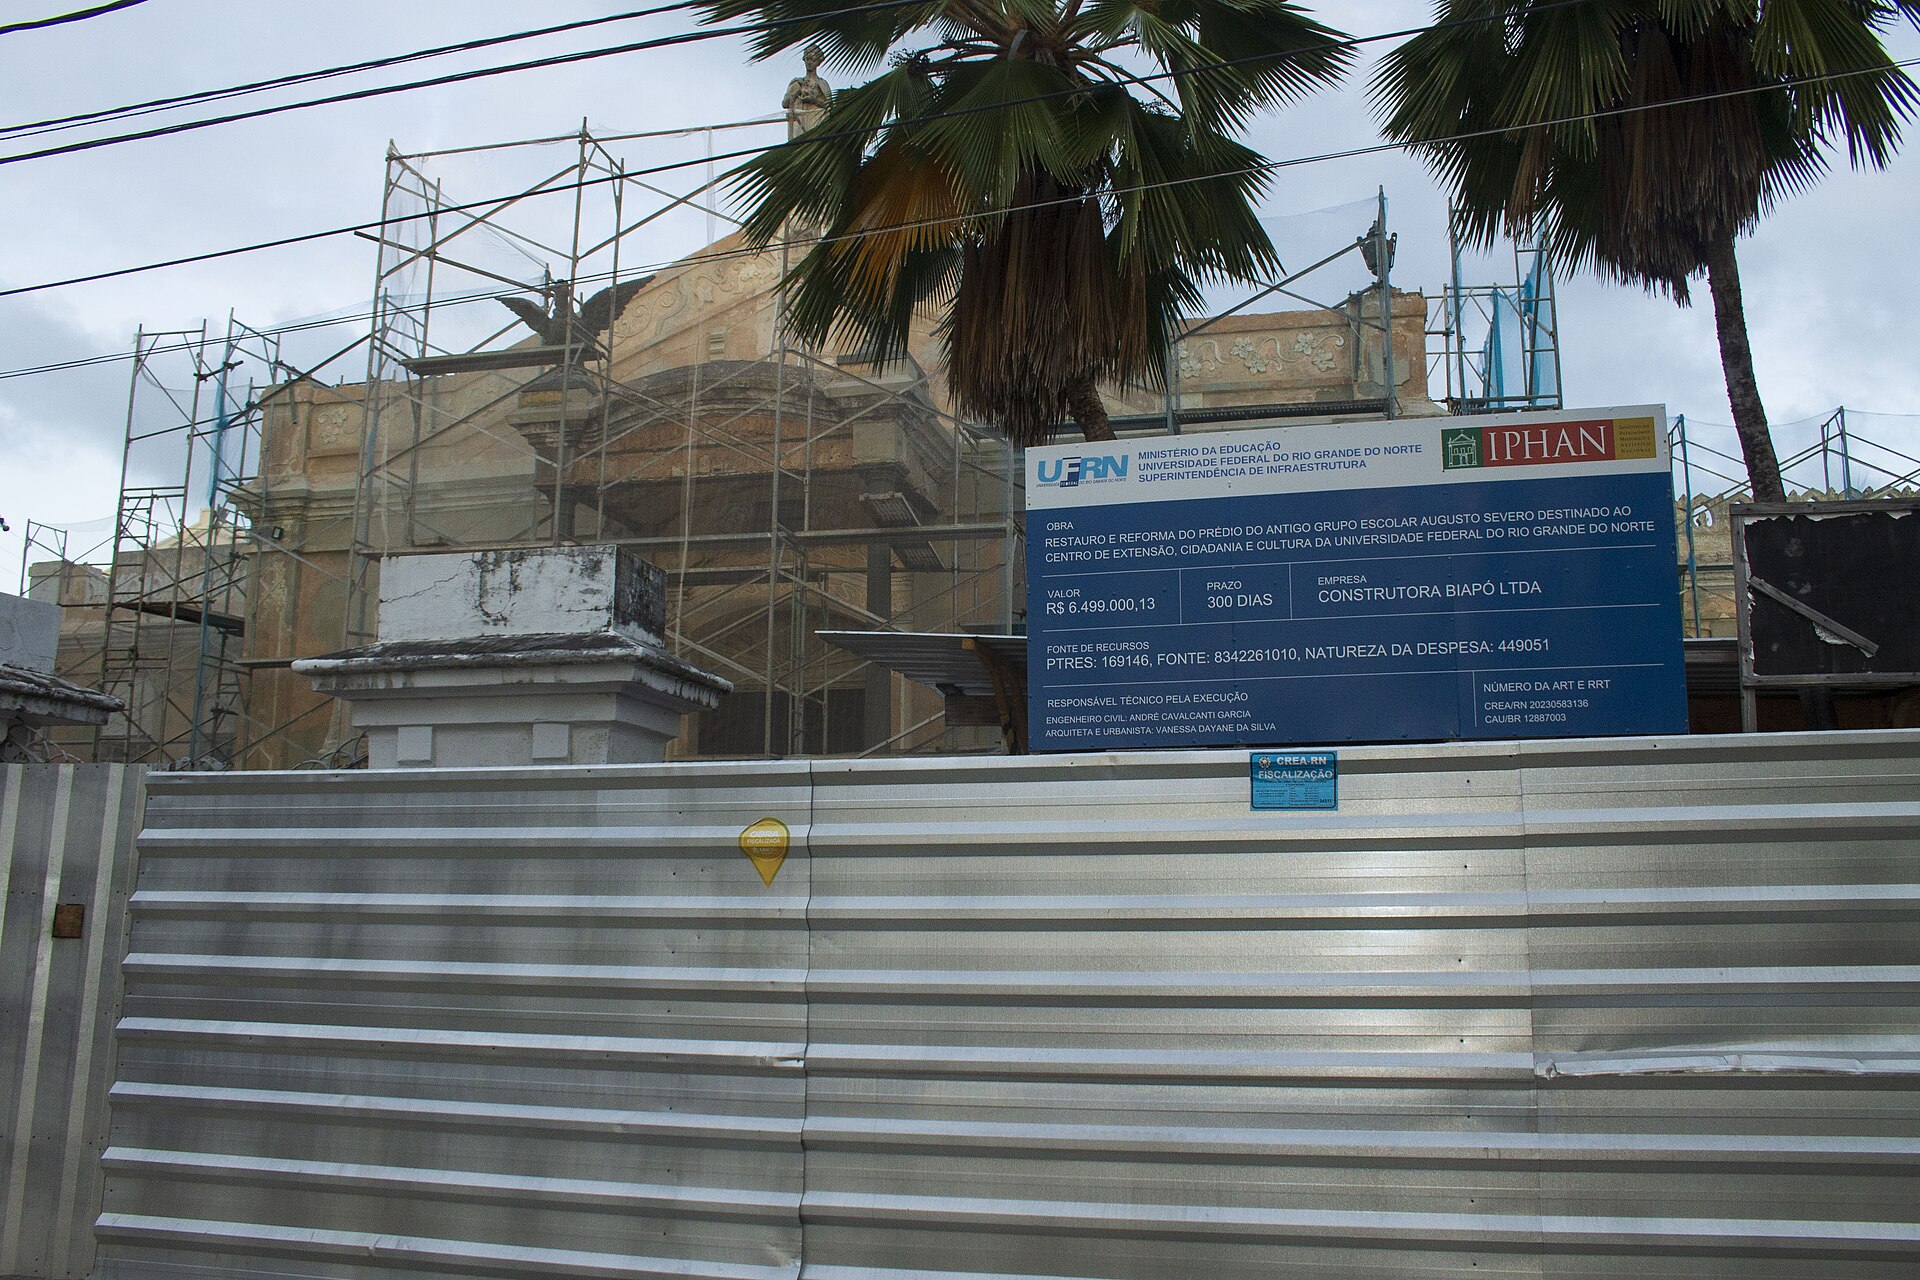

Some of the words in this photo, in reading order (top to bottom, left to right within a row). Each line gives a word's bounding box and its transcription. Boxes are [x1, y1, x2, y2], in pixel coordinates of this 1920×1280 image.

[1488, 425, 1607, 461] IPHAN
[1138, 447, 1199, 460] MINISTÉRIO
[1202, 447, 1216, 456] DA
[1220, 441, 1280, 454] EDUCAÇÃO
[1138, 458, 1218, 472] UNIVERSIDADE
[1220, 454, 1270, 466] FEDERAL
[1273, 453, 1289, 462] DO
[1292, 452, 1311, 461] RIO
[1314, 448, 1361, 459] GRANDE
[1364, 447, 1380, 456] DO
[1384, 444, 1422, 455] NORTE
[1038, 454, 1128, 482] UFRN
[1138, 468, 1246, 482] SUPERINTENDÊNCIA
[1249, 466, 1264, 475] DE
[1266, 460, 1366, 474] INFRAESTRUTURA
[1046, 522, 1074, 530] OBRA
[1046, 535, 1106, 548] RESTAURO
[1109, 534, 1116, 544] E
[1120, 530, 1176, 542] REFORMA
[1178, 530, 1196, 540] DO
[1199, 526, 1242, 538] PRÉDIO
[1246, 526, 1263, 536] DO
[1266, 523, 1310, 534] ANTIGO
[1314, 520, 1358, 532] GRUPO
[1360, 517, 1418, 529] ESCOLAR
[1420, 514, 1480, 526] AUGUSTO
[1484, 511, 1534, 522] SEVERO
[1538, 507, 1610, 520] DESTINADO
[1613, 506, 1632, 516] AO
[1046, 550, 1092, 562] CENTRO
[1094, 550, 1110, 560] DE
[1114, 544, 1177, 558] EXTENSÃO,
[1180, 542, 1243, 555] CIDADANIA
[1246, 542, 1253, 550] E
[1256, 538, 1312, 550] CULTURA
[1316, 537, 1332, 547] DA
[1334, 533, 1424, 546] UNIVERSIDADE
[1428, 530, 1482, 541] FEDERAL
[1486, 528, 1504, 538] DO
[1508, 526, 1530, 538] RIO
[1533, 524, 1586, 536] GRANDE
[1590, 523, 1608, 534] DO
[1612, 521, 1655, 532] NORTE
[1206, 580, 1242, 591] PRAZO
[1318, 575, 1367, 586] EMPRESA
[1047, 589, 1080, 598] VALOR
[1318, 585, 1441, 603] CONSTRUTORA
[1446, 580, 1494, 597] BIAPÓ
[1500, 580, 1542, 594] LTDA
[1046, 602, 1064, 615] R$
[1068, 598, 1155, 614] 6.499.000,13
[1207, 596, 1232, 608] 300
[1238, 594, 1272, 607] DIAS
[1046, 656, 1096, 670] PTRES:
[1102, 654, 1152, 668] 169146,
[1158, 652, 1210, 666] FONTE:
[1214, 648, 1300, 663] 8342261010,
[1306, 644, 1386, 660] NATUREZA
[1392, 643, 1412, 656] DA
[1418, 640, 1494, 655] DESPESA:
[1498, 639, 1549, 652] 449051
[1047, 644, 1078, 654] FONTE
[1080, 644, 1094, 652] DE
[1096, 642, 1150, 652] RECURSOS
[1484, 682, 1532, 692] NÚMERO
[1534, 682, 1550, 691] DA
[1552, 680, 1574, 690] ART
[1578, 680, 1584, 689] E
[1588, 680, 1610, 689] RRT
[1048, 696, 1118, 708] RESPONSÁVEL
[1120, 695, 1164, 705] TÉCNICO
[1166, 694, 1190, 704] PELA
[1194, 692, 1248, 703] EXECUÇÃO
[1484, 701, 1528, 710] CREA/RN
[1530, 699, 1588, 709] 20230583136
[1046, 714, 1102, 724] ENGENHEIRO
[1104, 714, 1128, 722] CIVIL:
[1129, 712, 1159, 722] ANDRÉ
[1162, 711, 1216, 720] CAVALCANTI
[1218, 710, 1252, 719] GARCIA
[1484, 714, 1522, 724] CAU/BR
[1524, 713, 1566, 722] 12887003
[1046, 728, 1094, 737] ARQUITETA
[1103, 726, 1154, 736] URBANISTA:
[1156, 725, 1196, 734] VANESSA
[1198, 724, 1234, 732] DAYANE
[1250, 722, 1276, 731] SILVA
[1276, 756, 1326, 765] CREA-RN
[1258, 769, 1333, 780] FISCALIZAÇÃO
